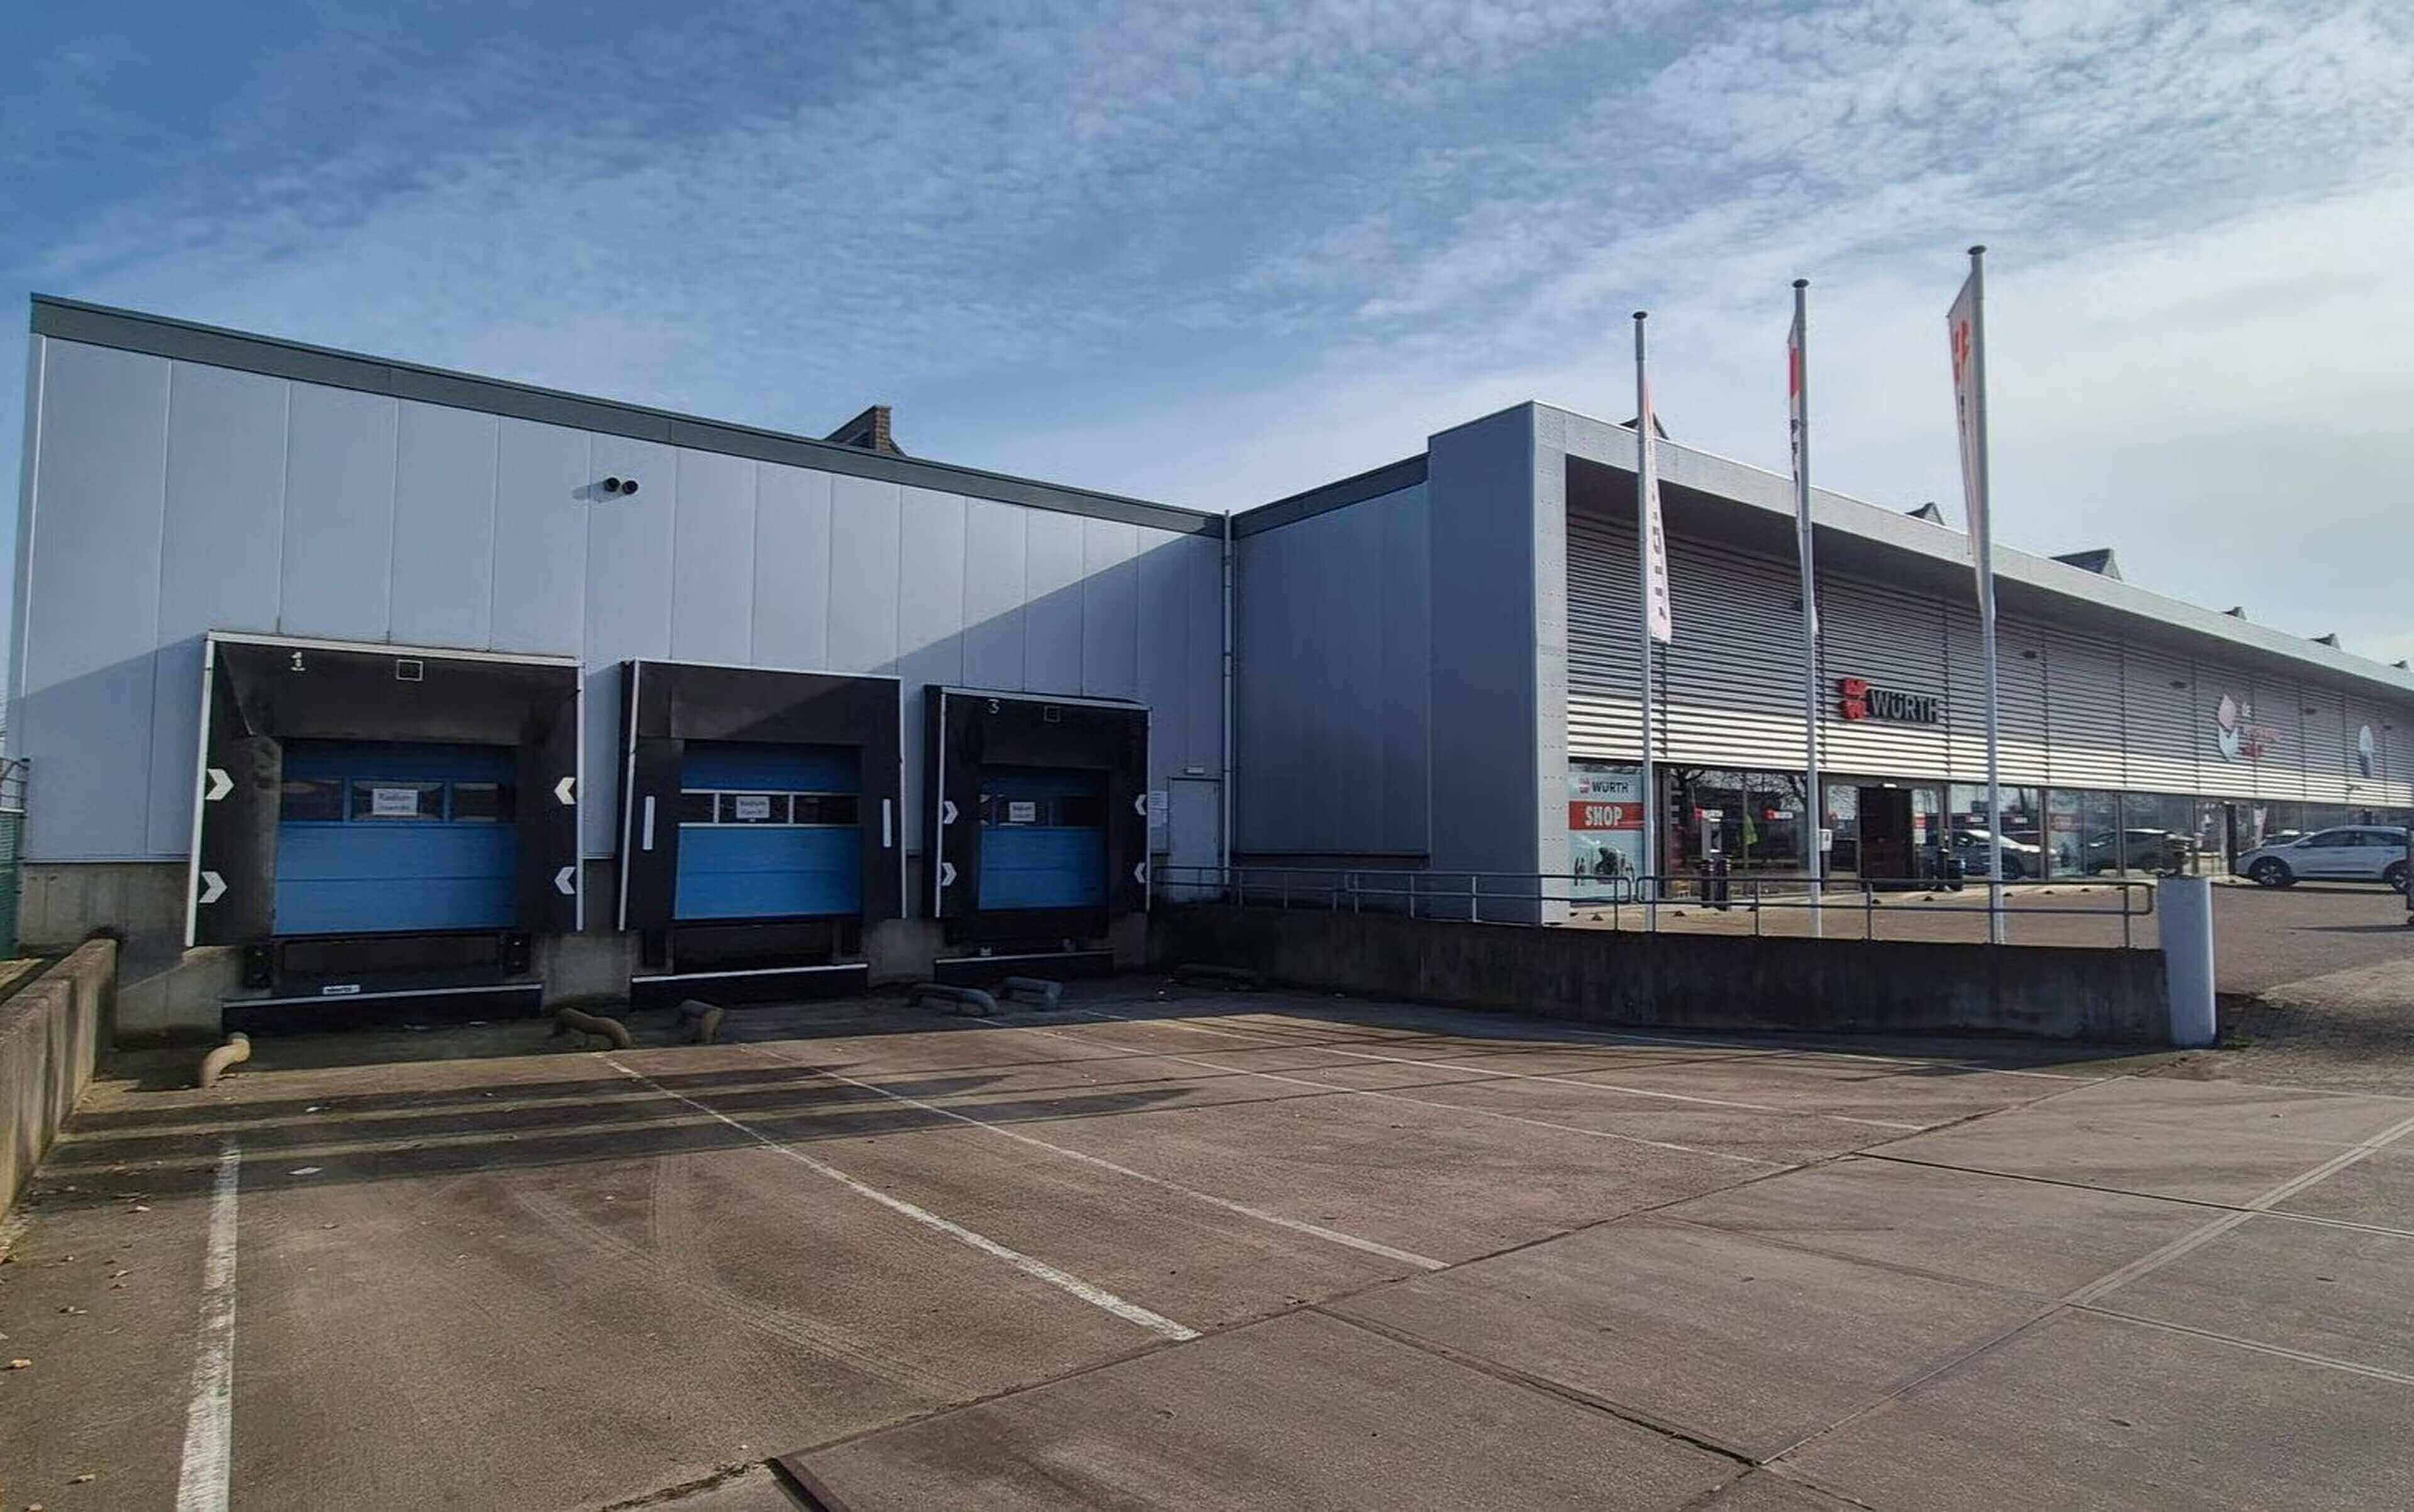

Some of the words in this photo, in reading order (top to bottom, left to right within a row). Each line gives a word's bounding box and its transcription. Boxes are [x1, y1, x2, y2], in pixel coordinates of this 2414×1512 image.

[290, 651, 306, 671] 1
[988, 698, 1000, 714] 3
[1868, 690, 1940, 723] WÜRTH
[1584, 805, 1623, 826] SHOP
